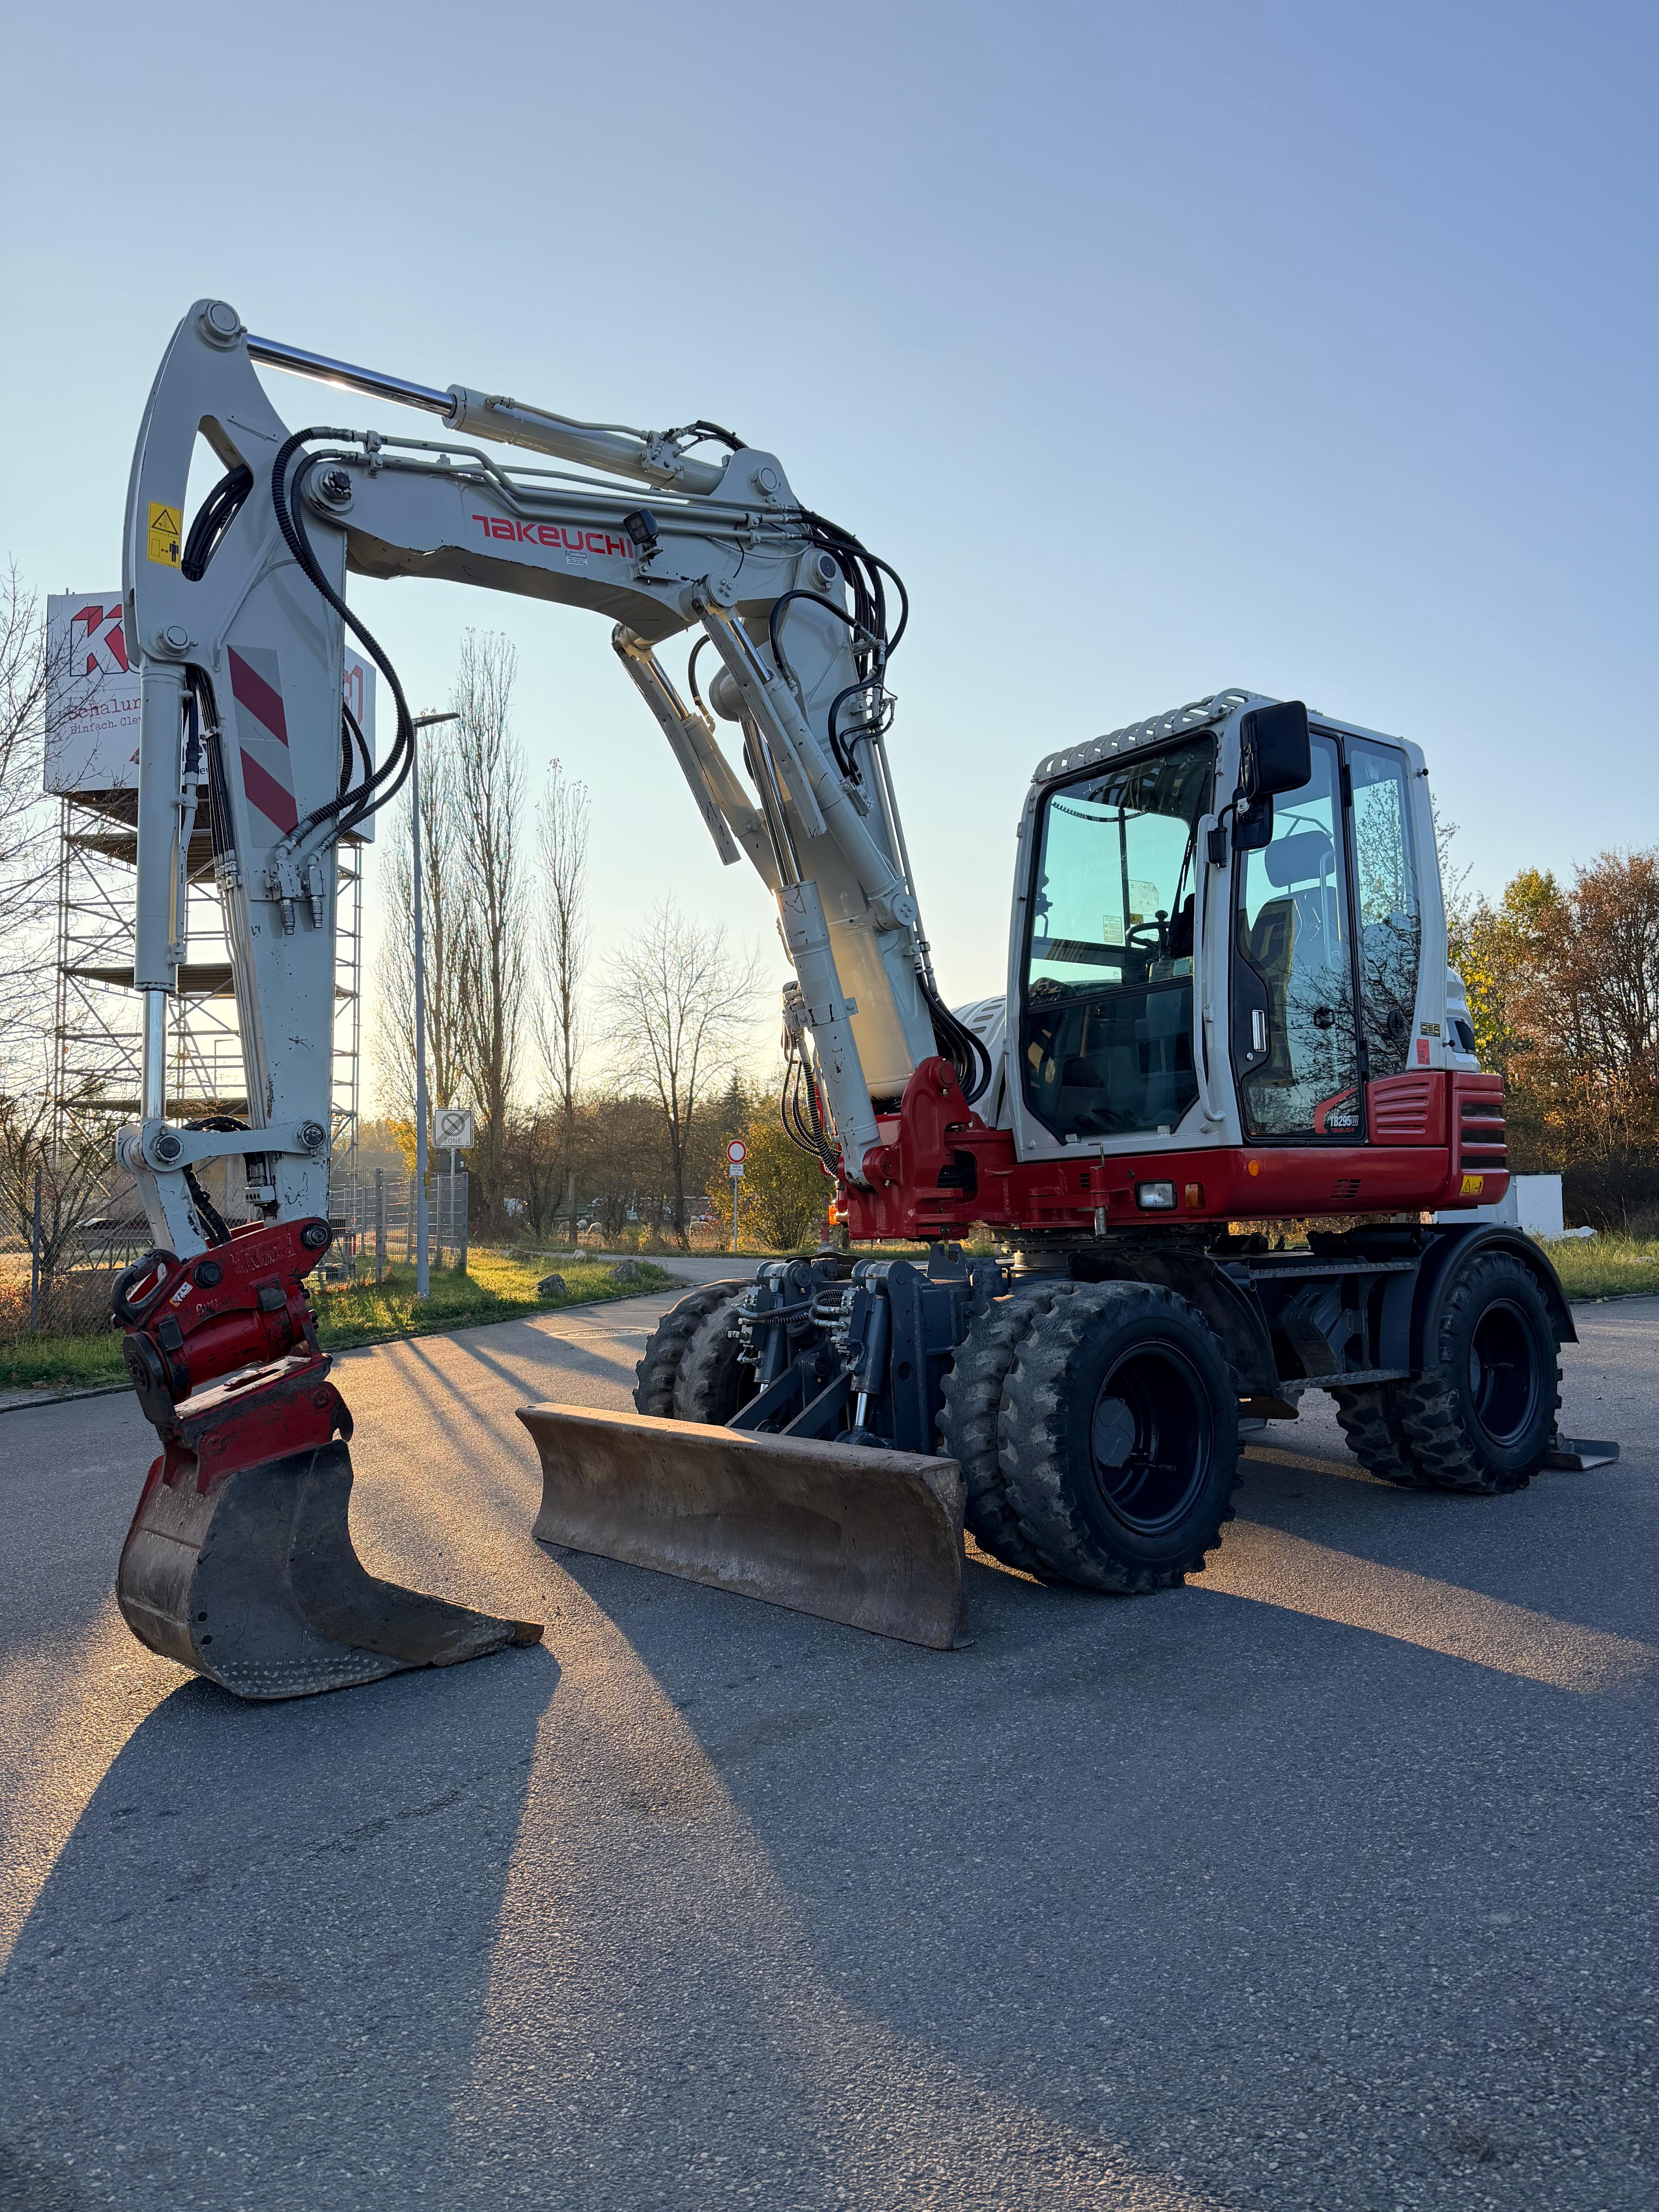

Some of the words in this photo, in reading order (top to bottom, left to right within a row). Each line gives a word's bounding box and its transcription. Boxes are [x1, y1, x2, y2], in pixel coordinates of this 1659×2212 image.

[472, 515, 633, 558] TAKEUCHI
[70, 720, 117, 734] Einfach.
[1330, 1115, 1359, 1127] TB295W
